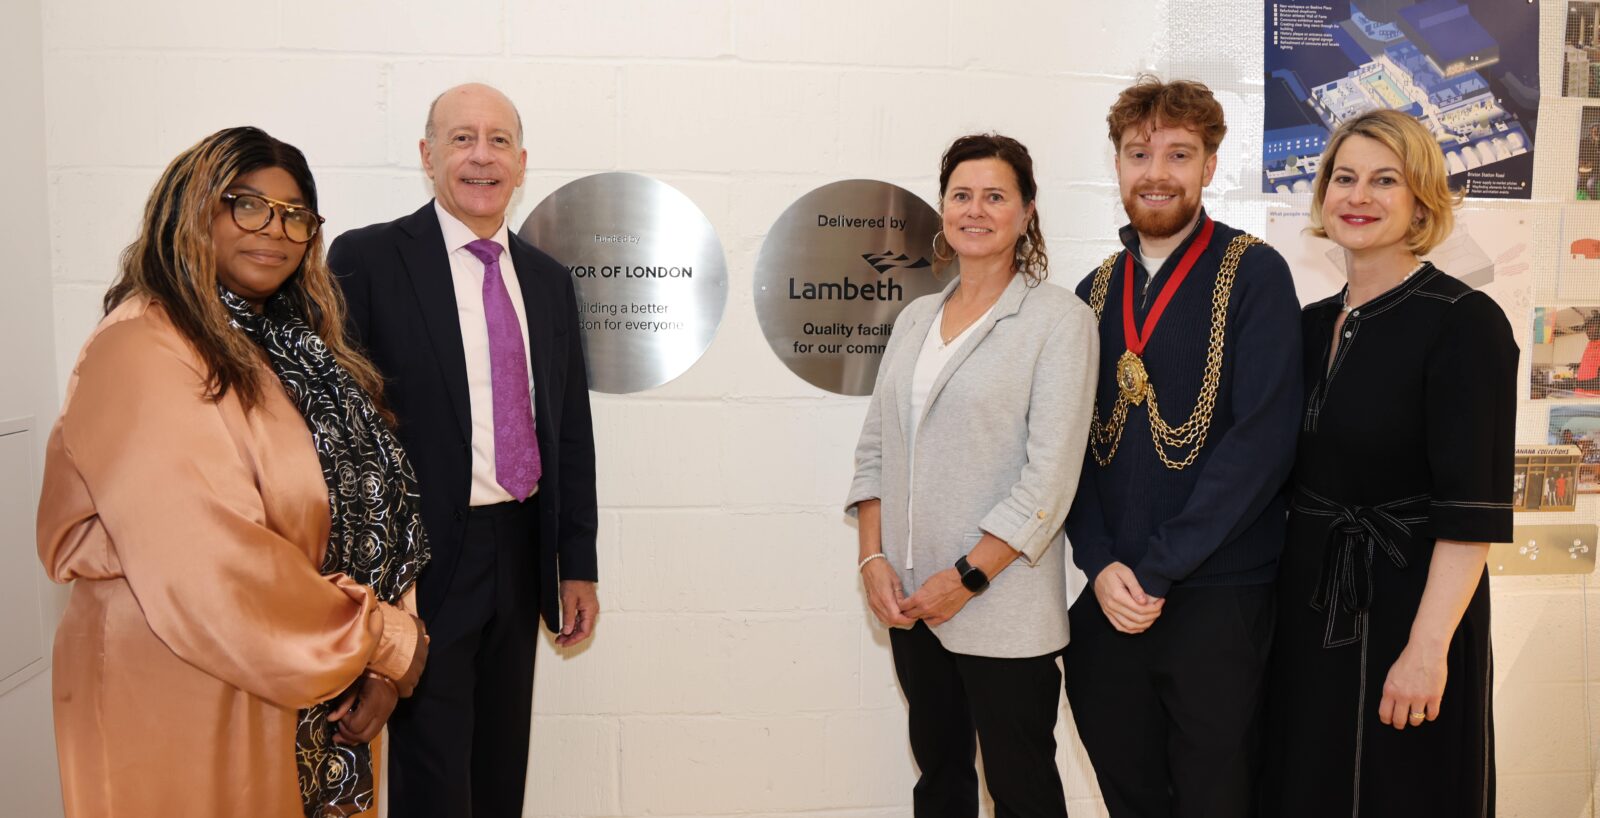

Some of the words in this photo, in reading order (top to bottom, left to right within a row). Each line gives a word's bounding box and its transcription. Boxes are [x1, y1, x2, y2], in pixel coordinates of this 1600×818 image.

[818, 215, 884, 228] Delivered
[890, 216, 906, 230] by
[594, 234, 627, 243] Funded
[628, 235, 640, 244] by
[566, 266, 596, 278] YOR
[601, 266, 621, 278] OF
[626, 266, 692, 278] LONDON
[790, 277, 902, 301] Lambeth
[578, 302, 617, 316] uilding
[620, 304, 628, 314] a
[631, 302, 668, 314] better
[579, 320, 600, 330] don
[605, 319, 621, 330] for
[625, 321, 684, 332] everyone
[803, 323, 854, 337] Quality
[858, 324, 894, 336] facili
[793, 341, 814, 353] for
[818, 344, 842, 354] our
[846, 344, 887, 354] comm
